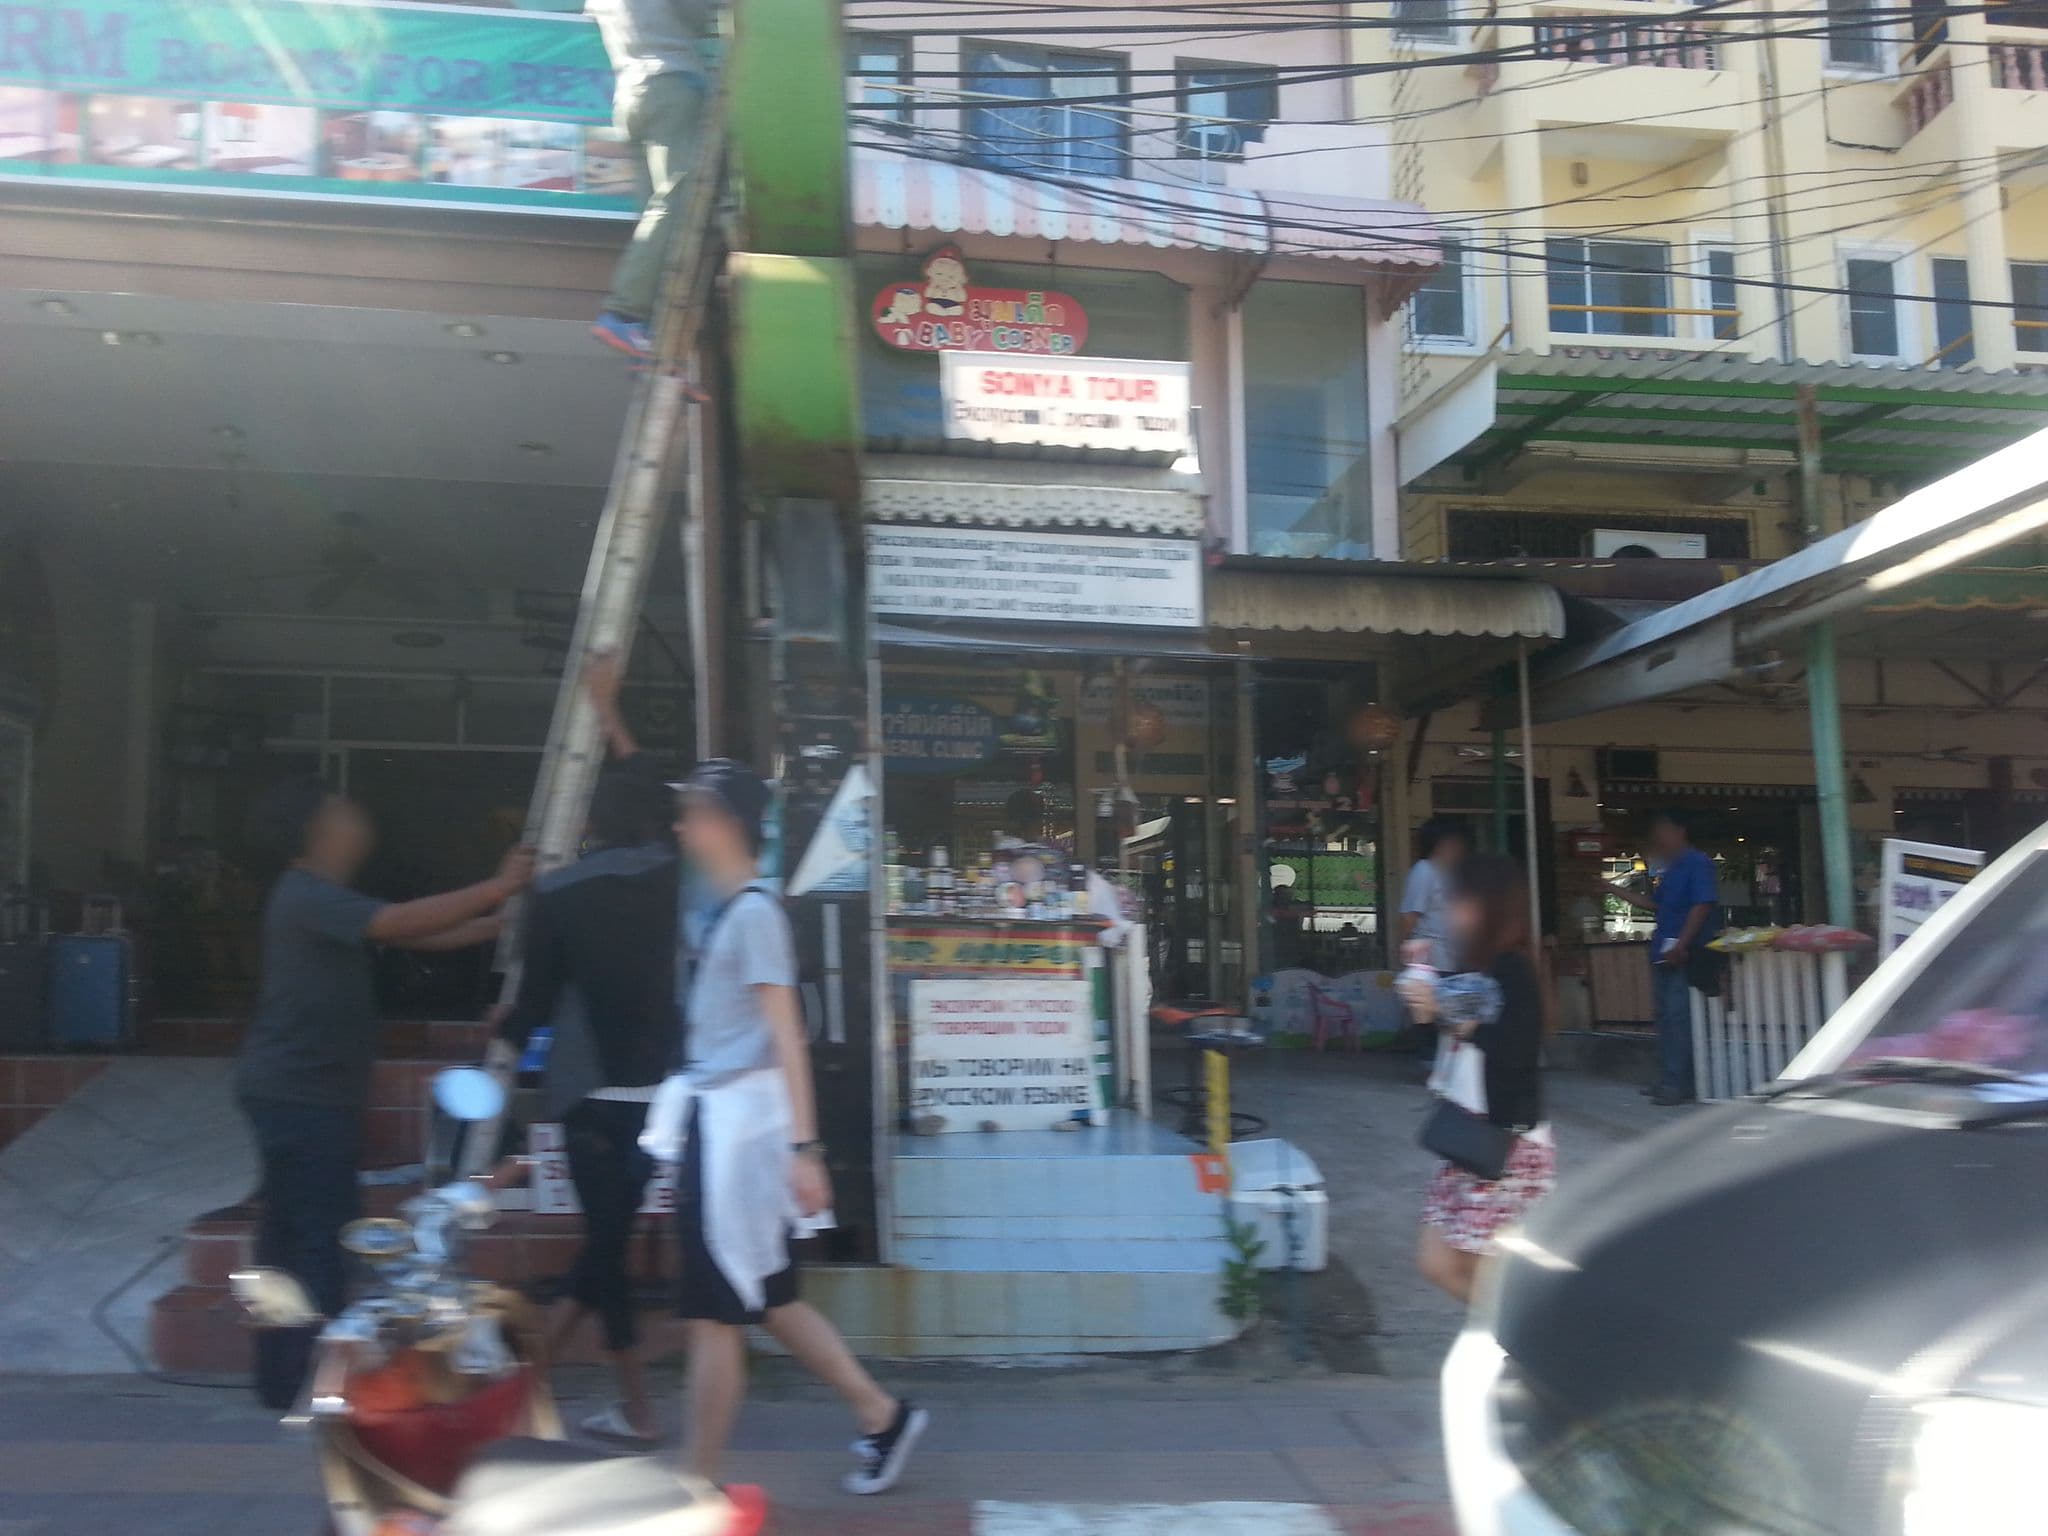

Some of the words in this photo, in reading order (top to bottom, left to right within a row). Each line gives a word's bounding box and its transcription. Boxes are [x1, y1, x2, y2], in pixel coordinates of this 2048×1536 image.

[376, 55, 494, 102] FOR
[918, 320, 983, 351] BABY
[991, 325, 1075, 355] CORNER
[983, 369, 1073, 399] SONYA
[1086, 375, 1159, 404] TOUR
[956, 1058, 1054, 1077] ГОВОРИМ
[1061, 1058, 1087, 1077] НА
[1022, 1085, 1089, 1105] ЯЗЫКЕ
